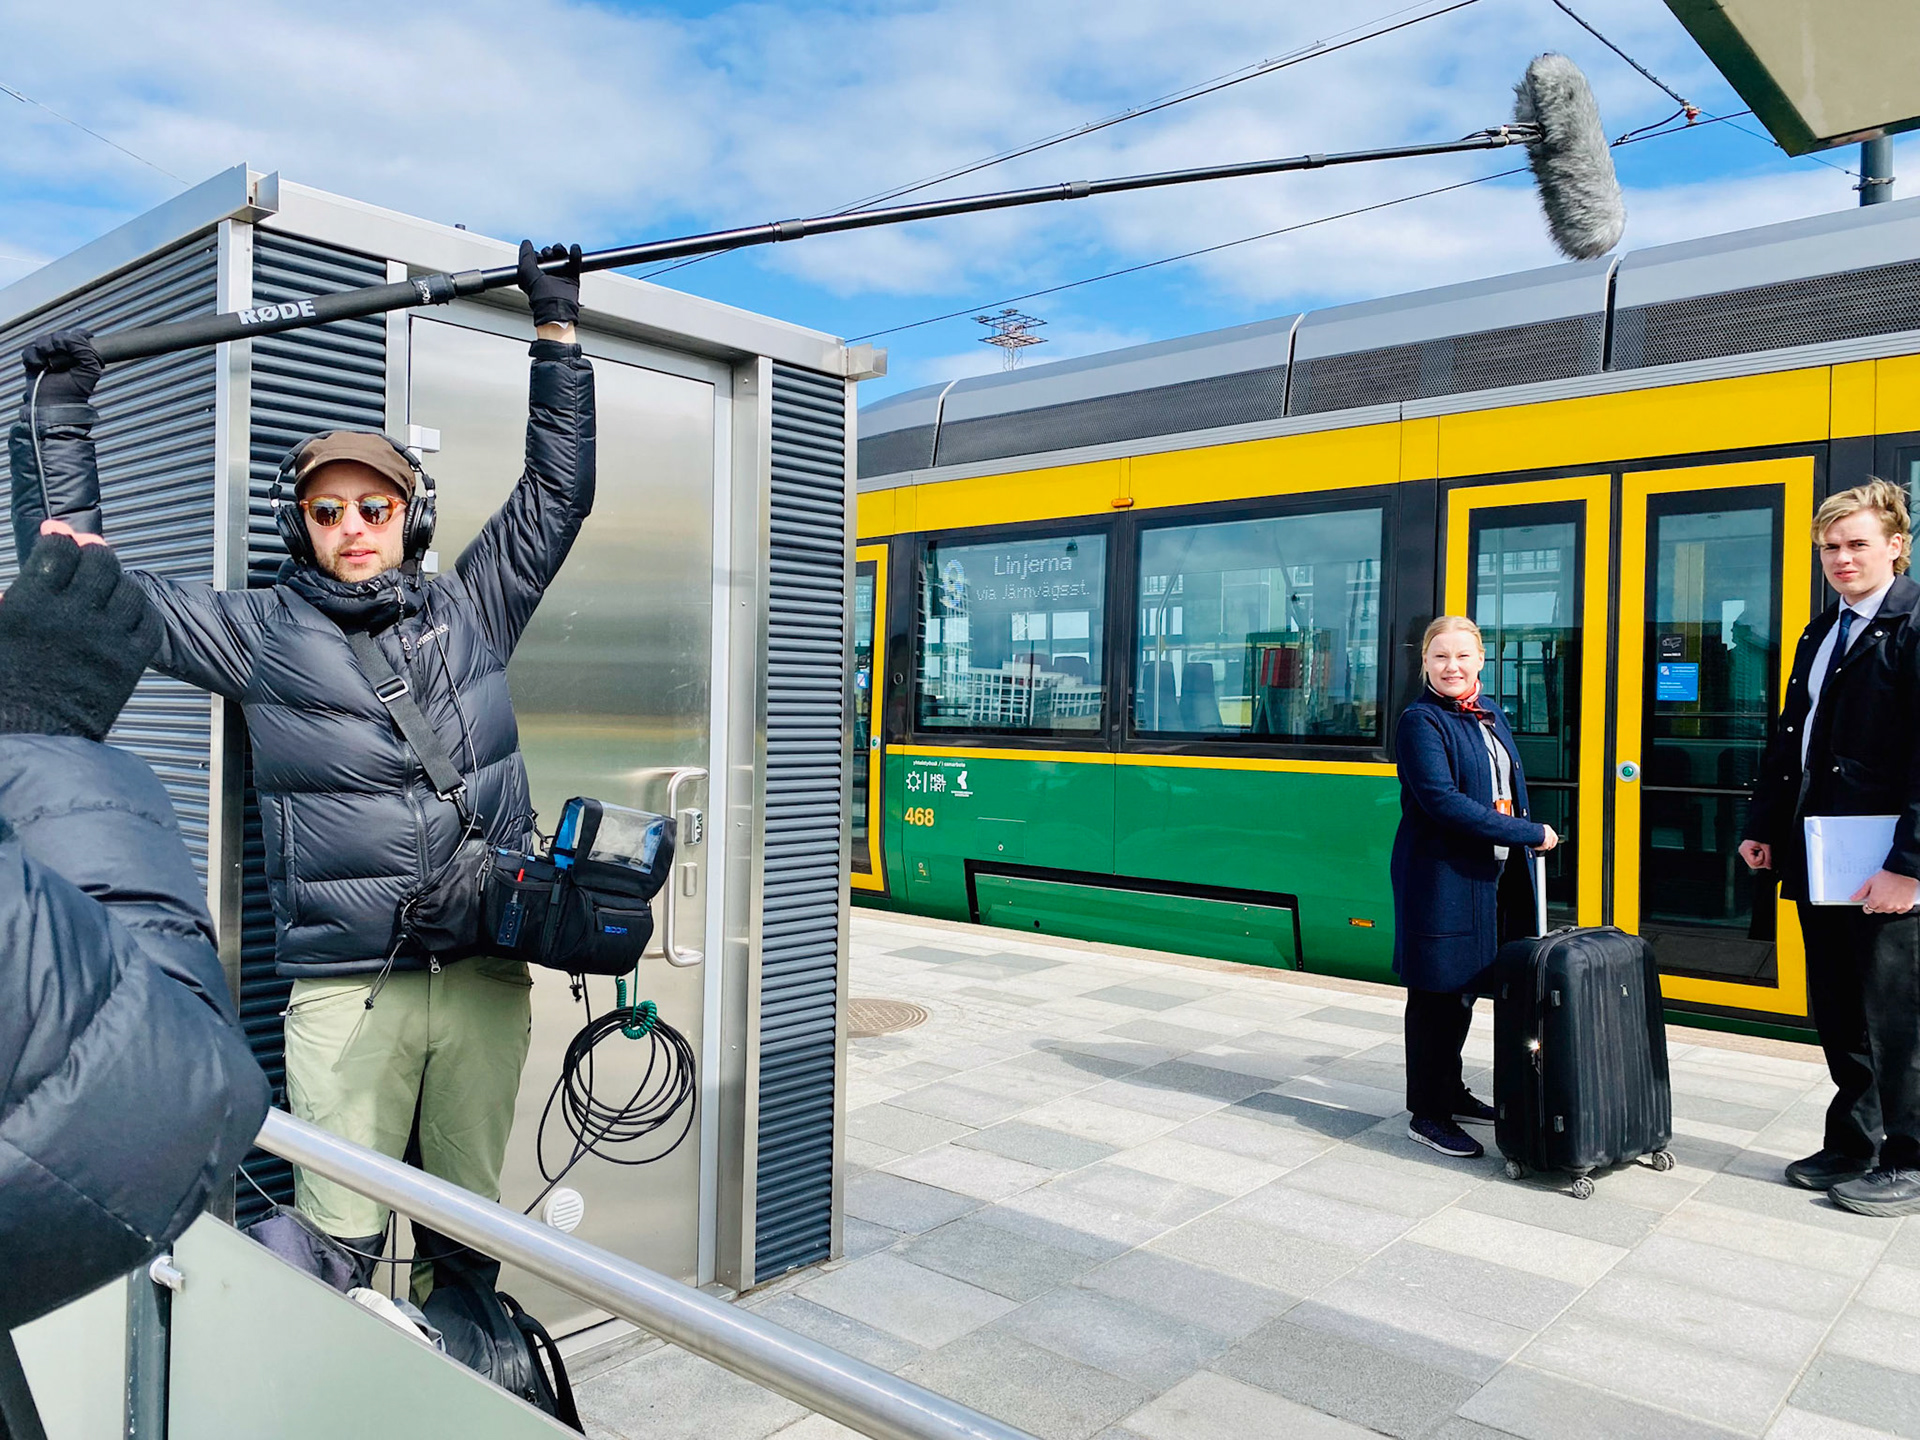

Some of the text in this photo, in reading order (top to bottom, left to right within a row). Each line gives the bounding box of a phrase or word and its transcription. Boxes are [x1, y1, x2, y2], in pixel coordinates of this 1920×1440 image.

[237, 300, 316, 325] RØDE
[994, 554, 1073, 580] Linjerna
[976, 580, 1090, 601] via Järnvägsst.
[929, 773, 946, 783] HSL
[929, 783, 947, 793] HRT
[904, 806, 935, 827] 468
